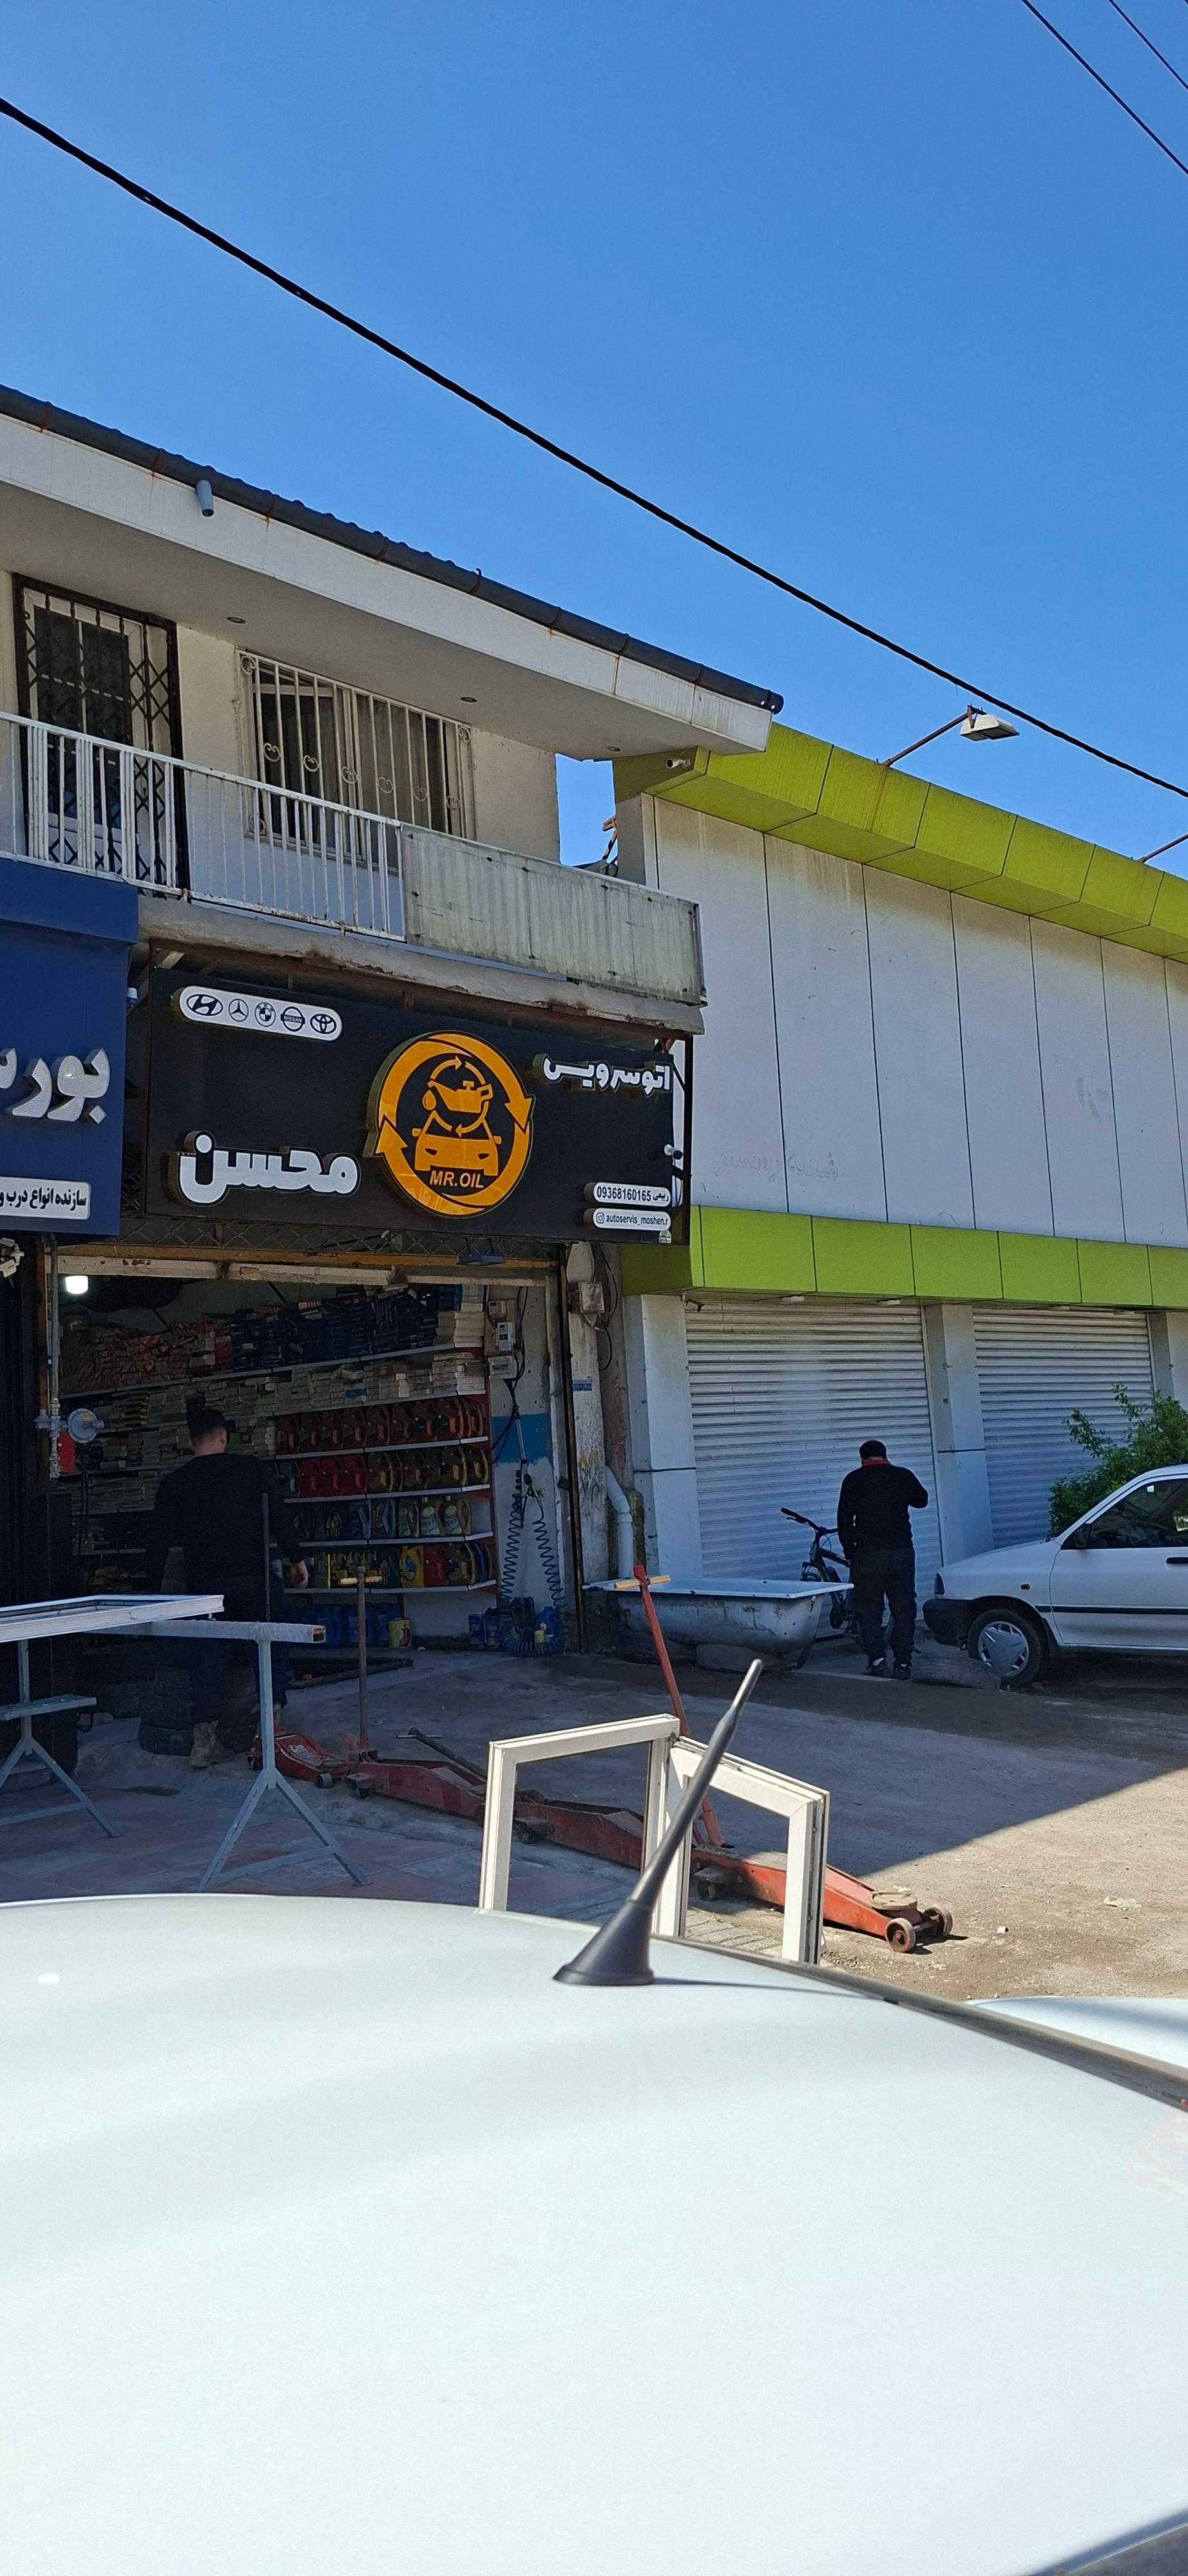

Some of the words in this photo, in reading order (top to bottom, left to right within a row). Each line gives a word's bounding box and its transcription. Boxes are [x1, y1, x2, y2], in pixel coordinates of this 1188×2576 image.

[283, 1014, 303, 1023] NISSAN
[0, 1048, 110, 1124] بور
[543, 1058, 671, 1095] اتوسرویس
[180, 1135, 358, 1204] محسن
[429, 1170, 484, 1188] MR.OIL
[6, 1189, 28, 1208] درب
[29, 1187, 54, 1209] انواع
[55, 1189, 87, 1211] سازنده
[597, 1186, 651, 1202] 09368160165
[606, 1214, 669, 1226] autoservis_moshen.r
